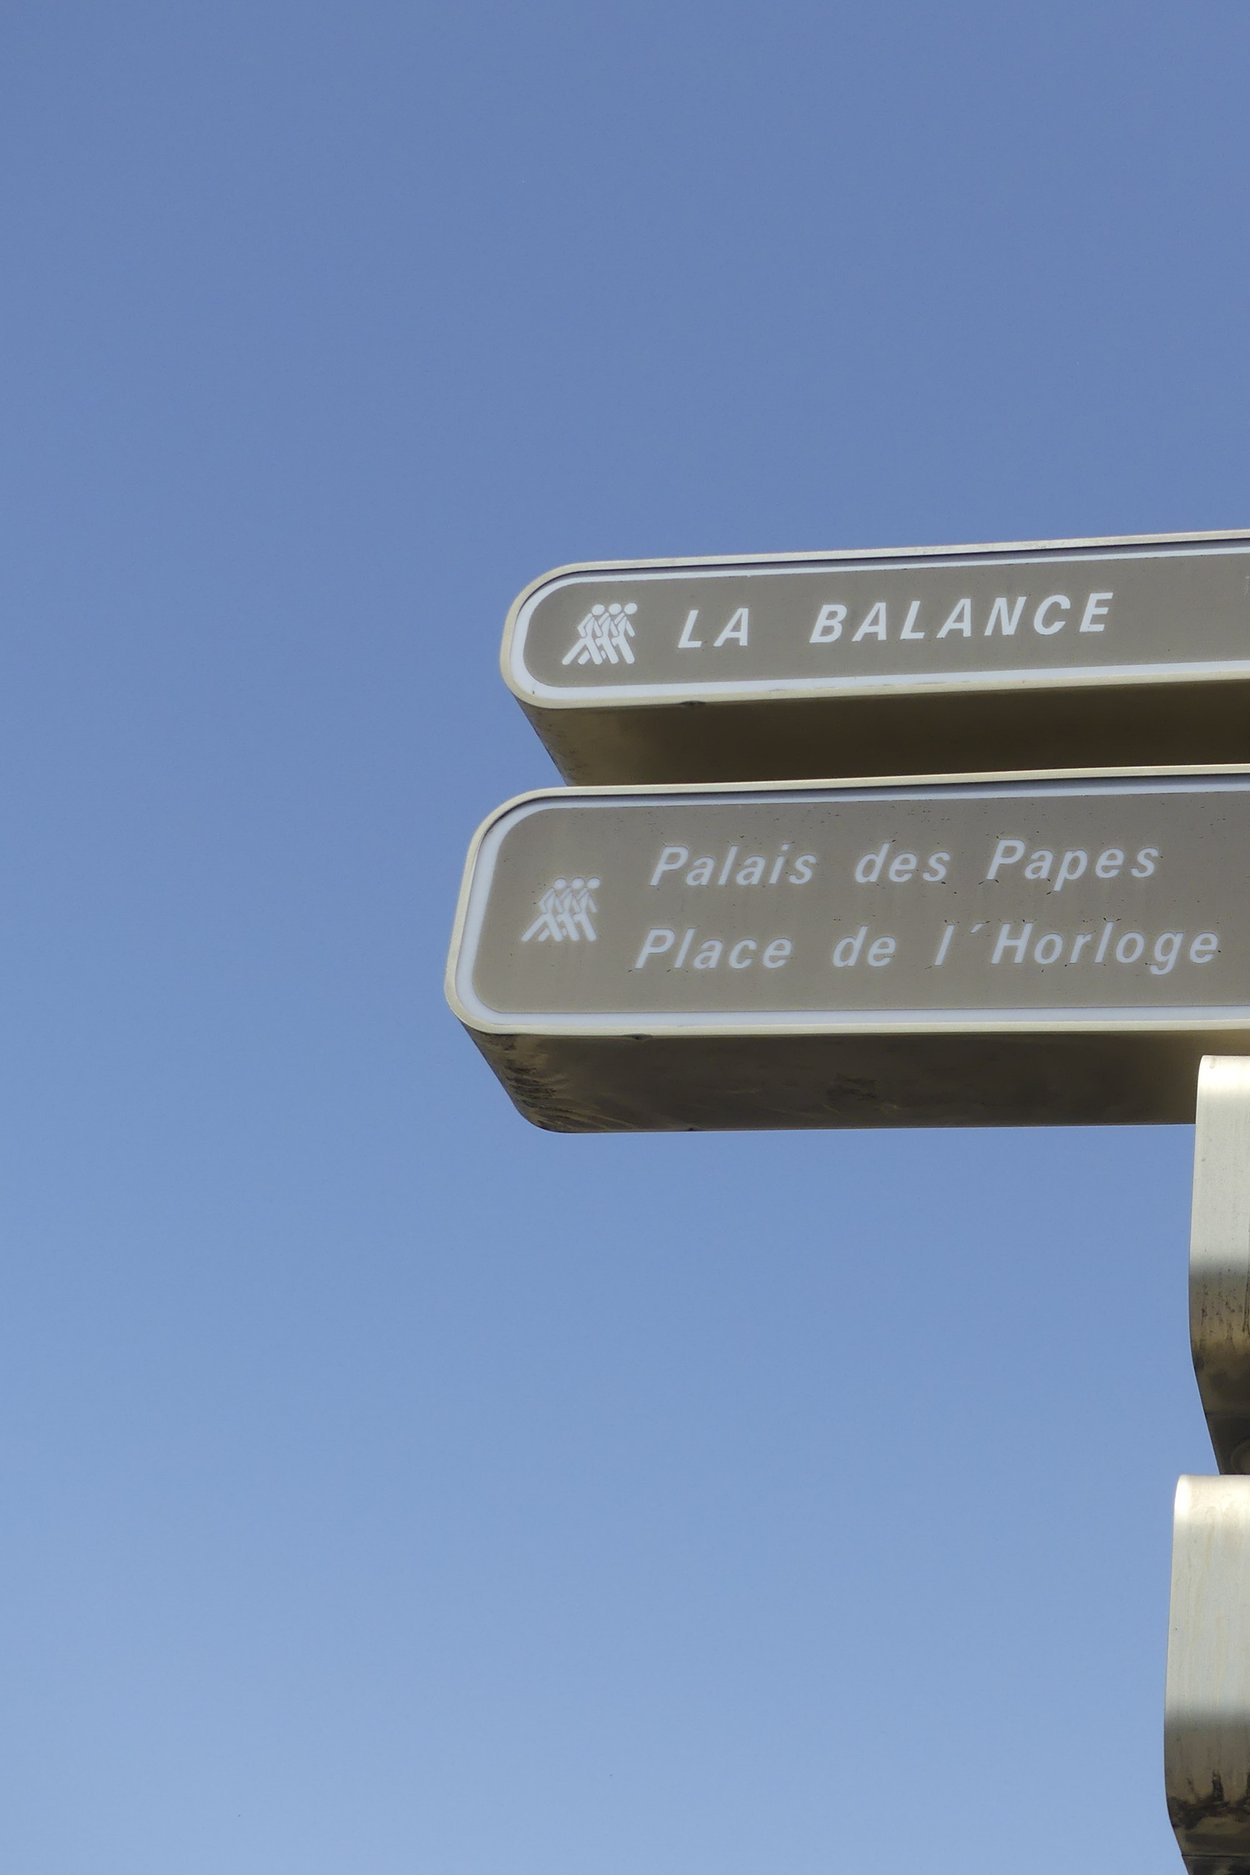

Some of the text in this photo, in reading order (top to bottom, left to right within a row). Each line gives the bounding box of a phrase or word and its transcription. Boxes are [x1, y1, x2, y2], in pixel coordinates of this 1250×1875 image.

[677, 591, 1114, 649] LA BALANCE
[650, 838, 1159, 892] Palais des Papes
[635, 927, 792, 970] Place
[832, 926, 896, 968] de
